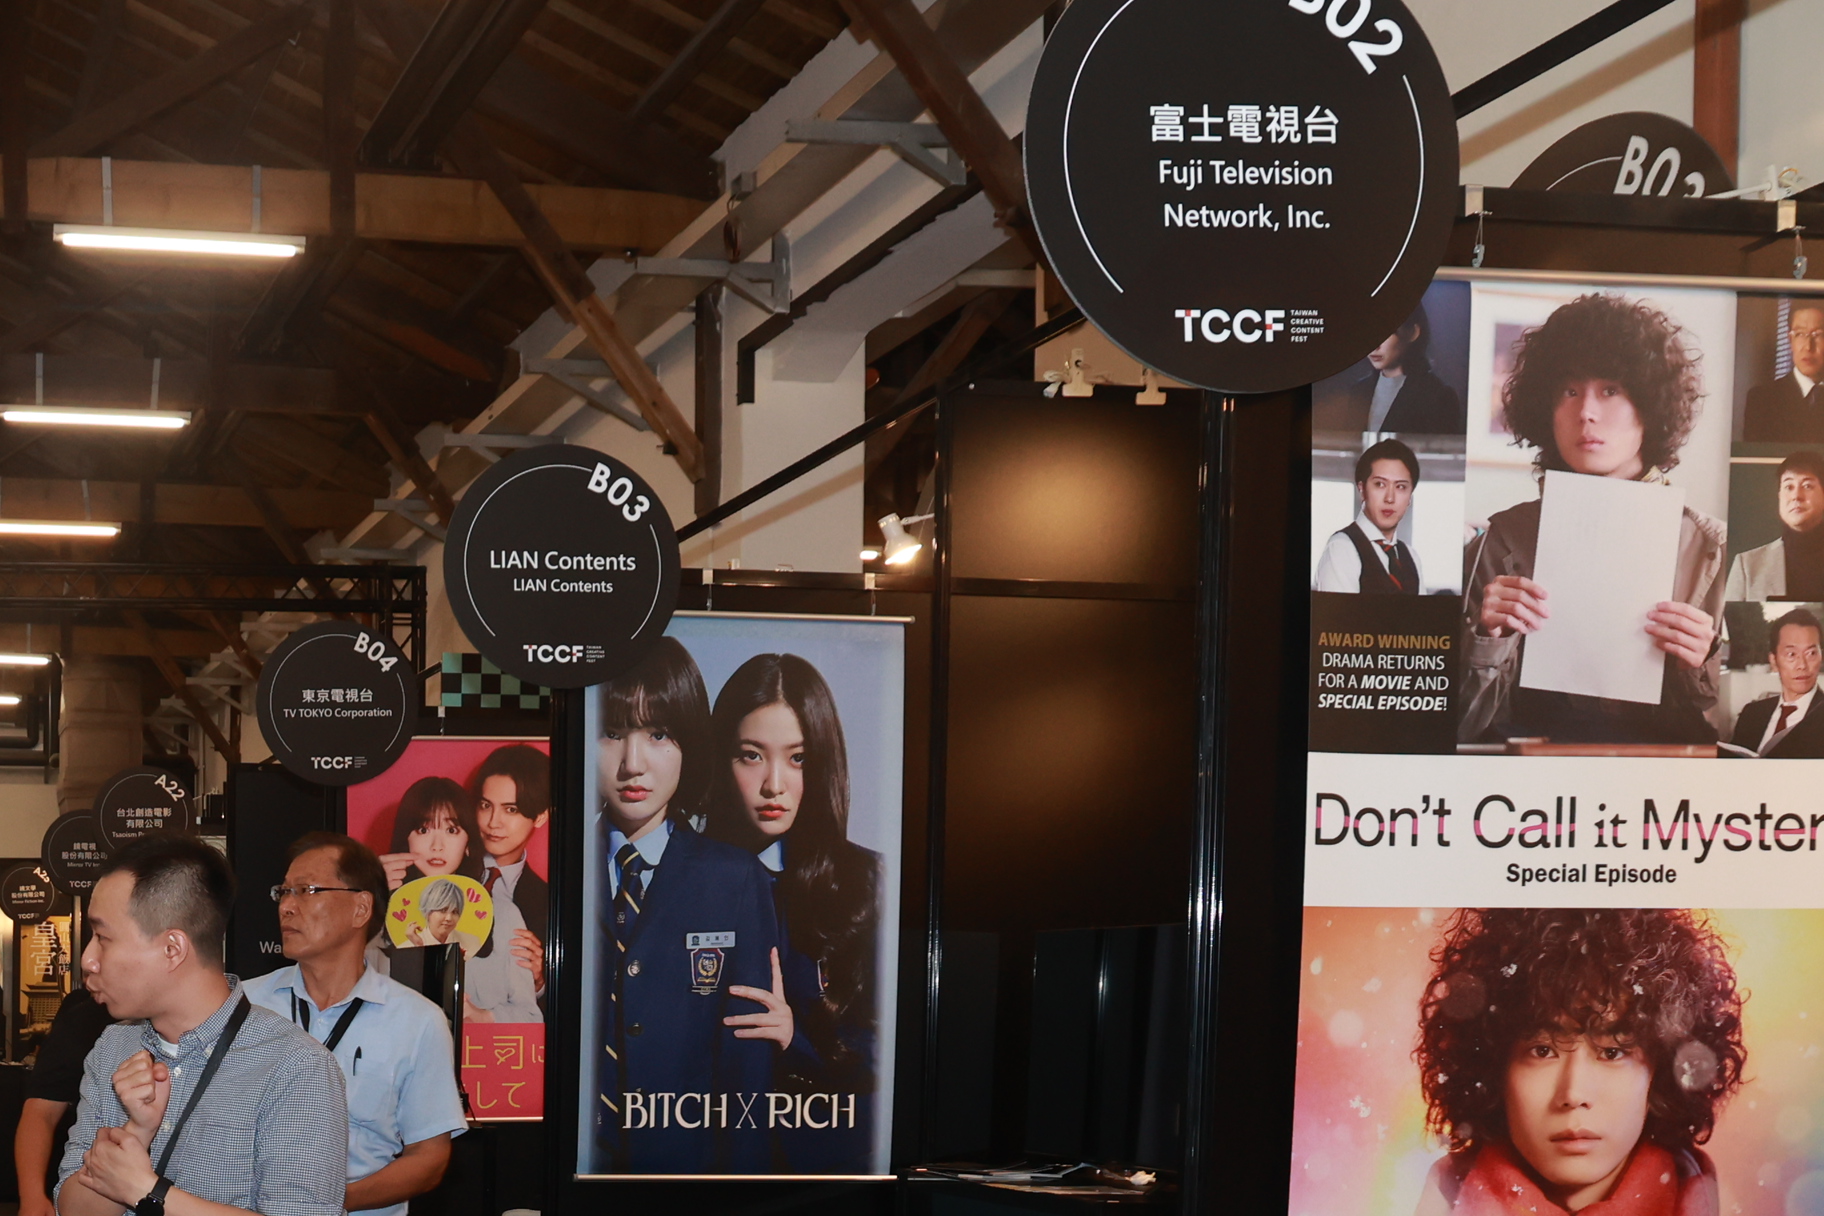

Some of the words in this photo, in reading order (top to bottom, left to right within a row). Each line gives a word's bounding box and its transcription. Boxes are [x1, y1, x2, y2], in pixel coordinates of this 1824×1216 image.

[1288, 0, 1404, 75] 02
[1150, 103, 1339, 144] 富士電視台
[1159, 159, 1203, 191] Fuji
[1209, 159, 1333, 185] Television
[1164, 203, 1280, 232] Network,
[1288, 204, 1330, 229] Inc.
[1175, 308, 1285, 344] TCCF
[587, 462, 651, 522] B03
[490, 550, 539, 569] LIAN
[544, 550, 637, 571] Contents
[513, 578, 547, 592] LIAN
[550, 578, 613, 593] Contents
[353, 631, 399, 673] B04
[1318, 632, 1374, 648] AWARD
[1378, 634, 1451, 649] WINNING
[523, 644, 584, 663] TCCF
[1322, 652, 1374, 668] DRAMA
[1378, 654, 1445, 670] RETURNS
[1318, 673, 1345, 688] FOR
[1347, 674, 1358, 689] A
[1360, 675, 1412, 690] MOVIE
[1414, 676, 1449, 691] AND
[302, 688, 374, 703] 東京電視台
[1318, 693, 1375, 709] SPECIAL
[1377, 695, 1448, 711] EPISODE!
[283, 708, 296, 718] TV
[298, 708, 332, 718] TOKYO
[334, 707, 393, 720] Corporation
[311, 756, 353, 769] TCCF
[154, 774, 186, 802] A22
[125, 819, 163, 829] 有限公司
[1314, 792, 1452, 848] Don't
[1473, 794, 1577, 849] Call
[1593, 803, 1628, 848] it
[1642, 798, 1824, 864] Myster
[69, 880, 92, 888] TCCF
[1506, 862, 1587, 887] Special
[1594, 864, 1677, 887] Episode
[463, 1081, 526, 1109] して
[622, 1092, 728, 1129] BITCH
[735, 1092, 758, 1129] X
[764, 1092, 856, 1129] RICH
